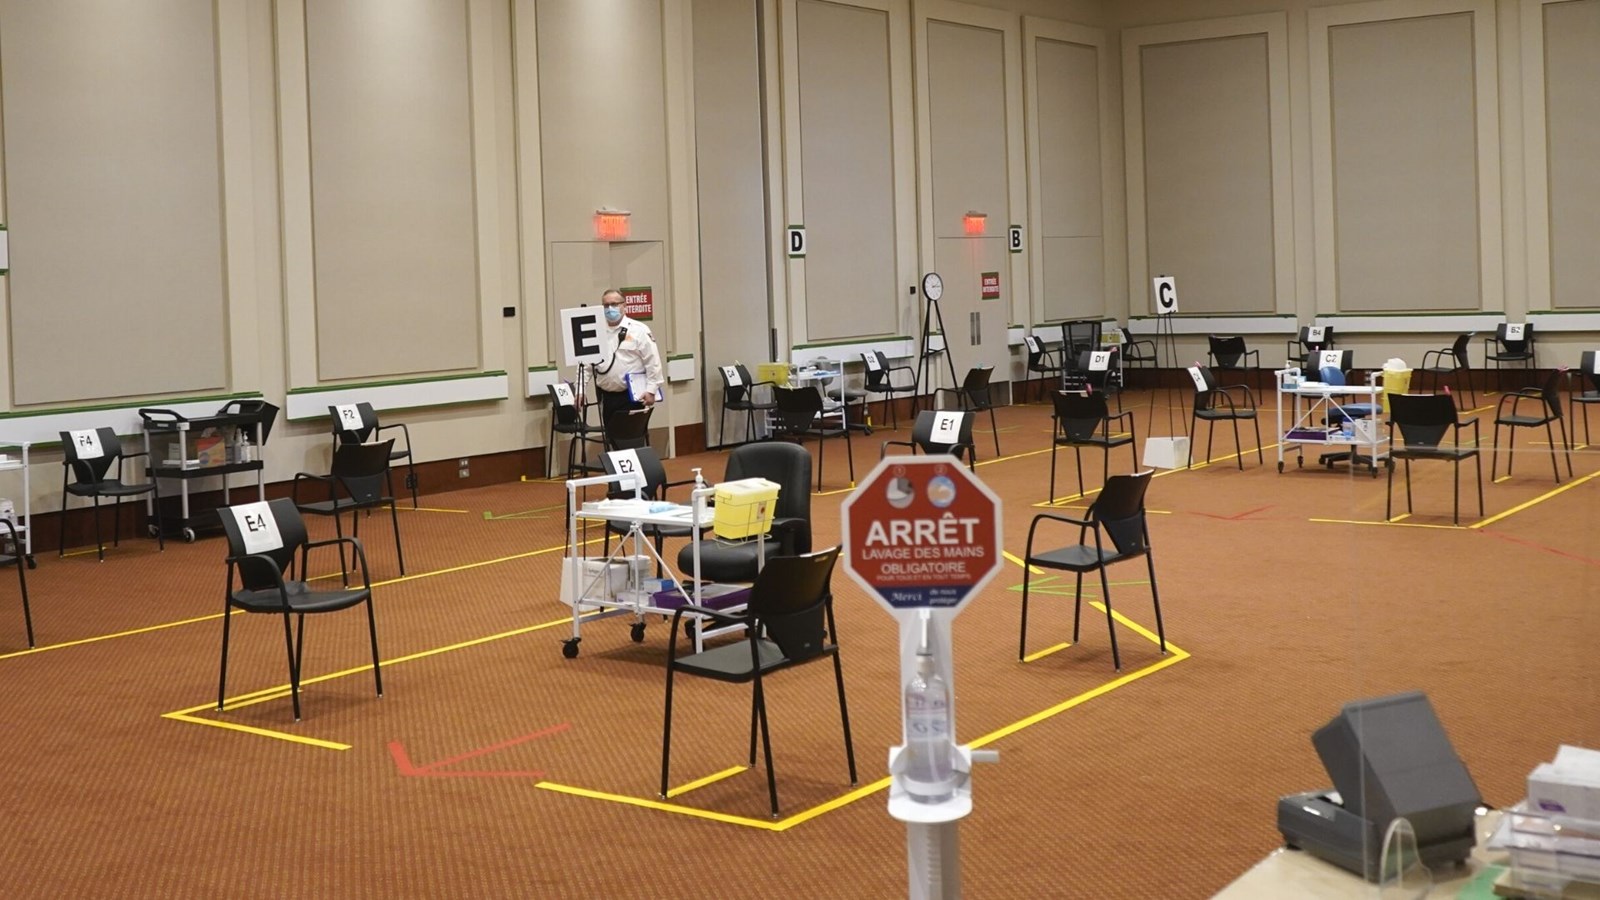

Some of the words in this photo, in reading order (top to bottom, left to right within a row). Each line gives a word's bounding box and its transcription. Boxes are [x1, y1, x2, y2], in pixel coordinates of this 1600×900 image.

[791, 231, 803, 252] D
[1012, 230, 1021, 248] B
[625, 293, 648, 304] ENTRÉE
[1159, 282, 1174, 308] C
[625, 304, 652, 314] NTERDITE
[571, 314, 601, 357] E
[1095, 355, 1105, 363] D1
[1325, 354, 1337, 363] C2
[343, 410, 355, 420] F2
[940, 418, 954, 431] E1
[79, 435, 93, 447] F4
[618, 459, 635, 474] E2
[244, 514, 266, 532] E4
[865, 511, 980, 546] ARRÊT
[862, 548, 911, 560] LAVAGE
[914, 547, 941, 558] DES
[944, 546, 985, 558] MAINS
[881, 561, 966, 574] OBLIGATOIRE
[890, 591, 922, 602] Merci
